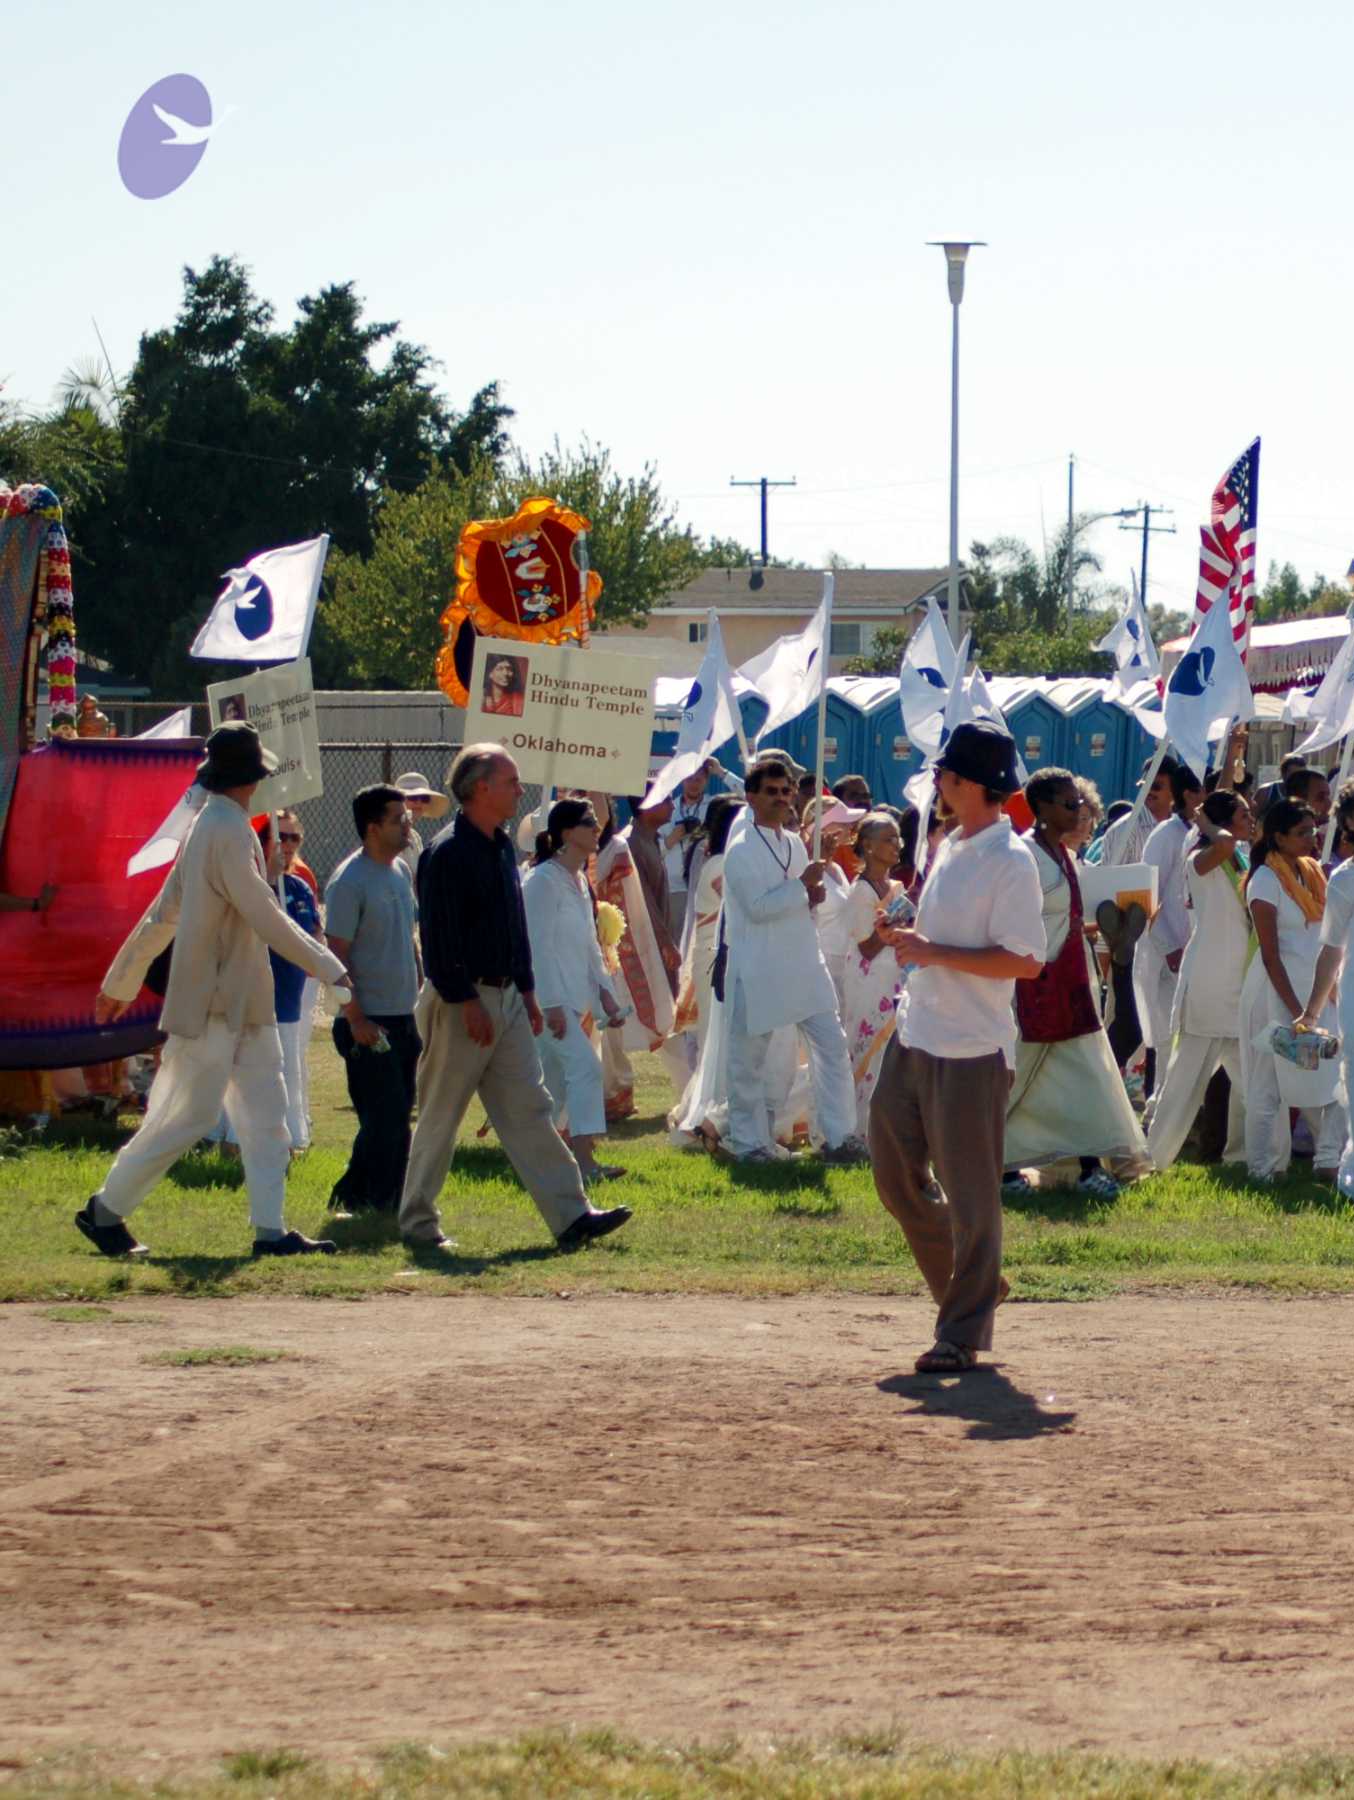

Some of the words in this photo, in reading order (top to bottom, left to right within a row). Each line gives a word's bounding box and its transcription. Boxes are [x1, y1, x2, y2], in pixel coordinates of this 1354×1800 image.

[531, 672, 648, 698] Dhyanapeetam
[530, 690, 580, 708] Hindu
[585, 697, 645, 716] Temple
[512, 733, 607, 759] Oklahoma
